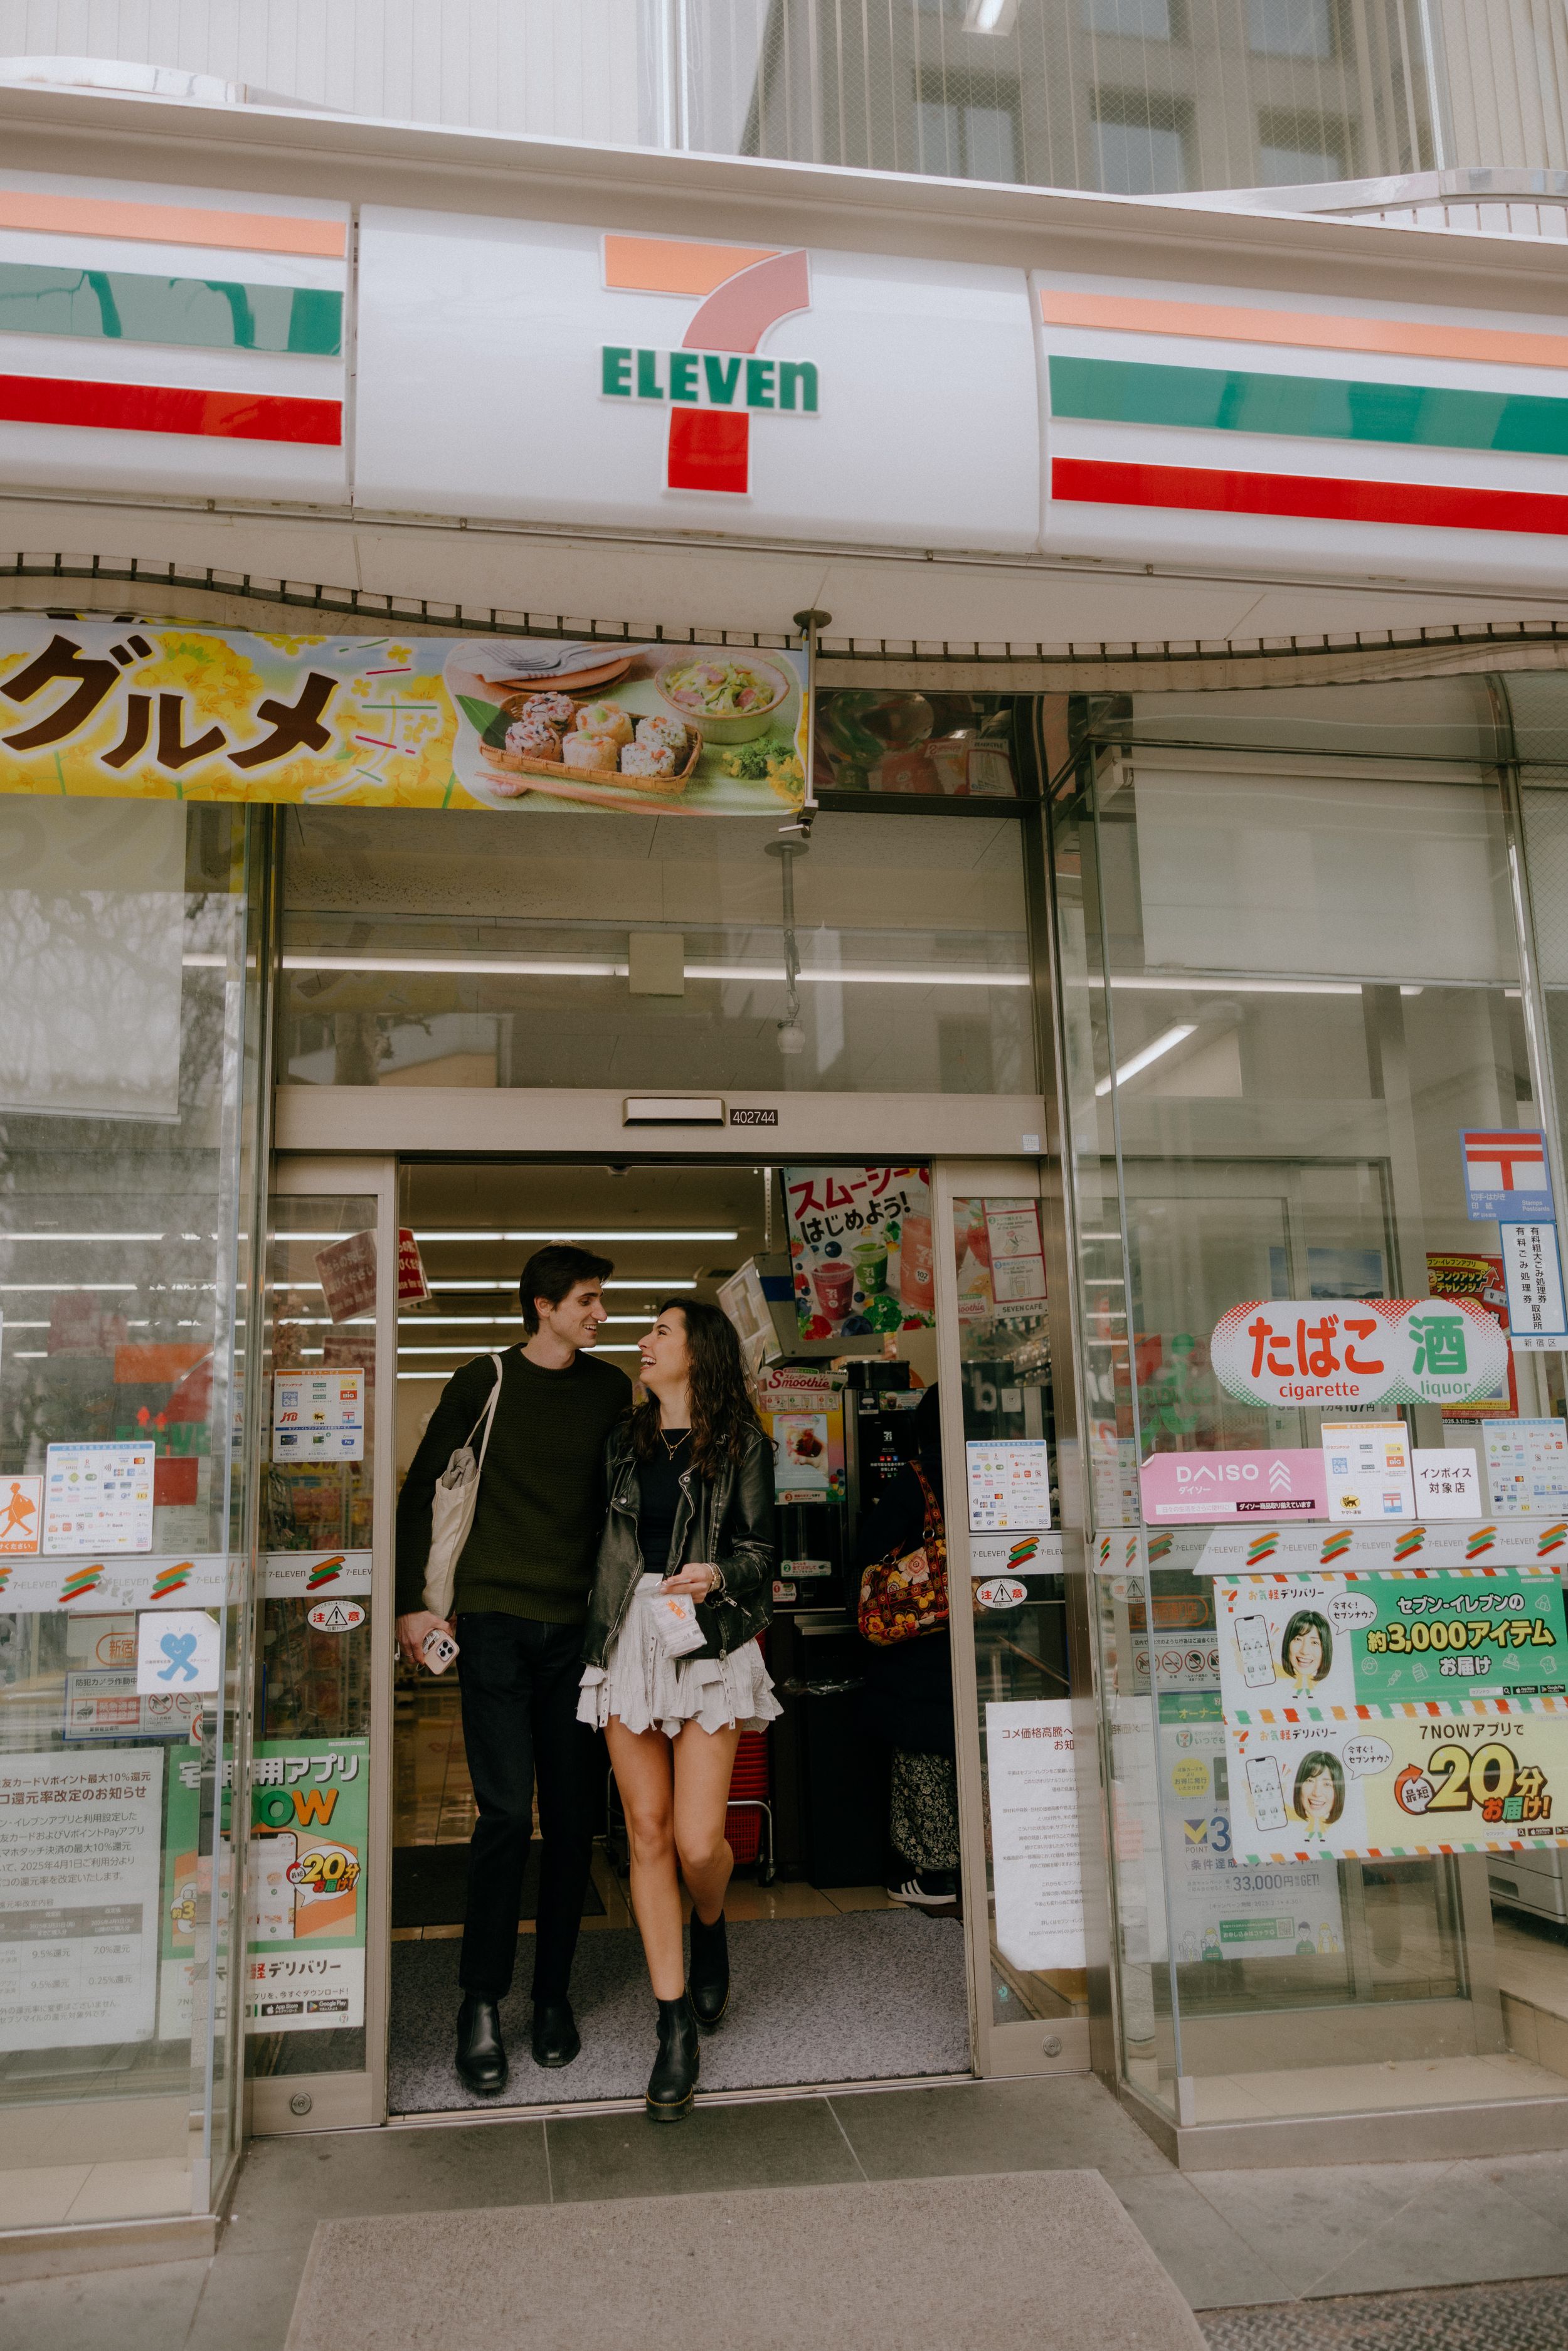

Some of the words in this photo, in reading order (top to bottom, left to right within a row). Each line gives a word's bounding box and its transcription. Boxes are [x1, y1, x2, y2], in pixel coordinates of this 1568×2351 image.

[0, 634, 339, 769] グルメ
[733, 1111, 775, 1123] 402744
[800, 1191, 911, 1245] はじめよう!
[1515, 1226, 1532, 1303] 有料ごみ処理券
[1530, 1226, 1547, 1303] 有料粗大ごみ処理券
[1436, 1270, 1485, 1282] ランクアップ
[1436, 1282, 1477, 1293] チャレンジ
[1002, 1305, 1024, 1313] SEVEN
[1025, 1303, 1043, 1311] CAFÉ
[1530, 1304, 1543, 1330] 取扱所
[1248, 1313, 1384, 1378] たばこ
[1407, 1315, 1468, 1375] 酒
[1523, 1338, 1557, 1348] 新宿区
[768, 1371, 830, 1389] Smoothie
[1279, 1381, 1360, 1401] cigarette
[1420, 1380, 1471, 1398] liquor
[1176, 1464, 1259, 1483] DAISO
[1420, 1468, 1472, 1479] インボイス
[1179, 1486, 1211, 1495] ダイソー
[1428, 1482, 1466, 1494] 対象店
[1239, 1501, 1311, 1510] ダイソー商品取り揃えています
[980, 1590, 993, 1600] 注
[1011, 1588, 1024, 1598] 意
[1248, 1588, 1325, 1601] お気軽デリバリー
[312, 1613, 326, 1623] 注
[347, 1611, 360, 1621] 意
[1367, 1618, 1557, 1655] 約3,000アイテム
[1439, 1655, 1491, 1677] お届け
[75, 1676, 137, 1687] 防犯カメラ作動中
[1179, 1707, 1224, 1719] オーナー
[1259, 1728, 1337, 1741] お気軽デリバリー
[1419, 1722, 1524, 1740] 7NOWアプリで
[0, 1771, 151, 1788] 友カードVポイント最大10%還元
[1428, 1742, 1548, 1813] 20分
[1405, 1786, 1430, 1803] 最短
[1482, 1795, 1552, 1823] お届け!
[0, 1841, 132, 1857] マホタッチ決済の最大10%還元
[0, 1871, 124, 1888] コの還元率を改定いたします。
[31, 1947, 71, 1959] 9.5%還元
[93, 1945, 130, 1955] 7.0%還元
[31, 1979, 70, 1989] 9.5%還元
[88, 1975, 133, 1986] 0.25%還元
